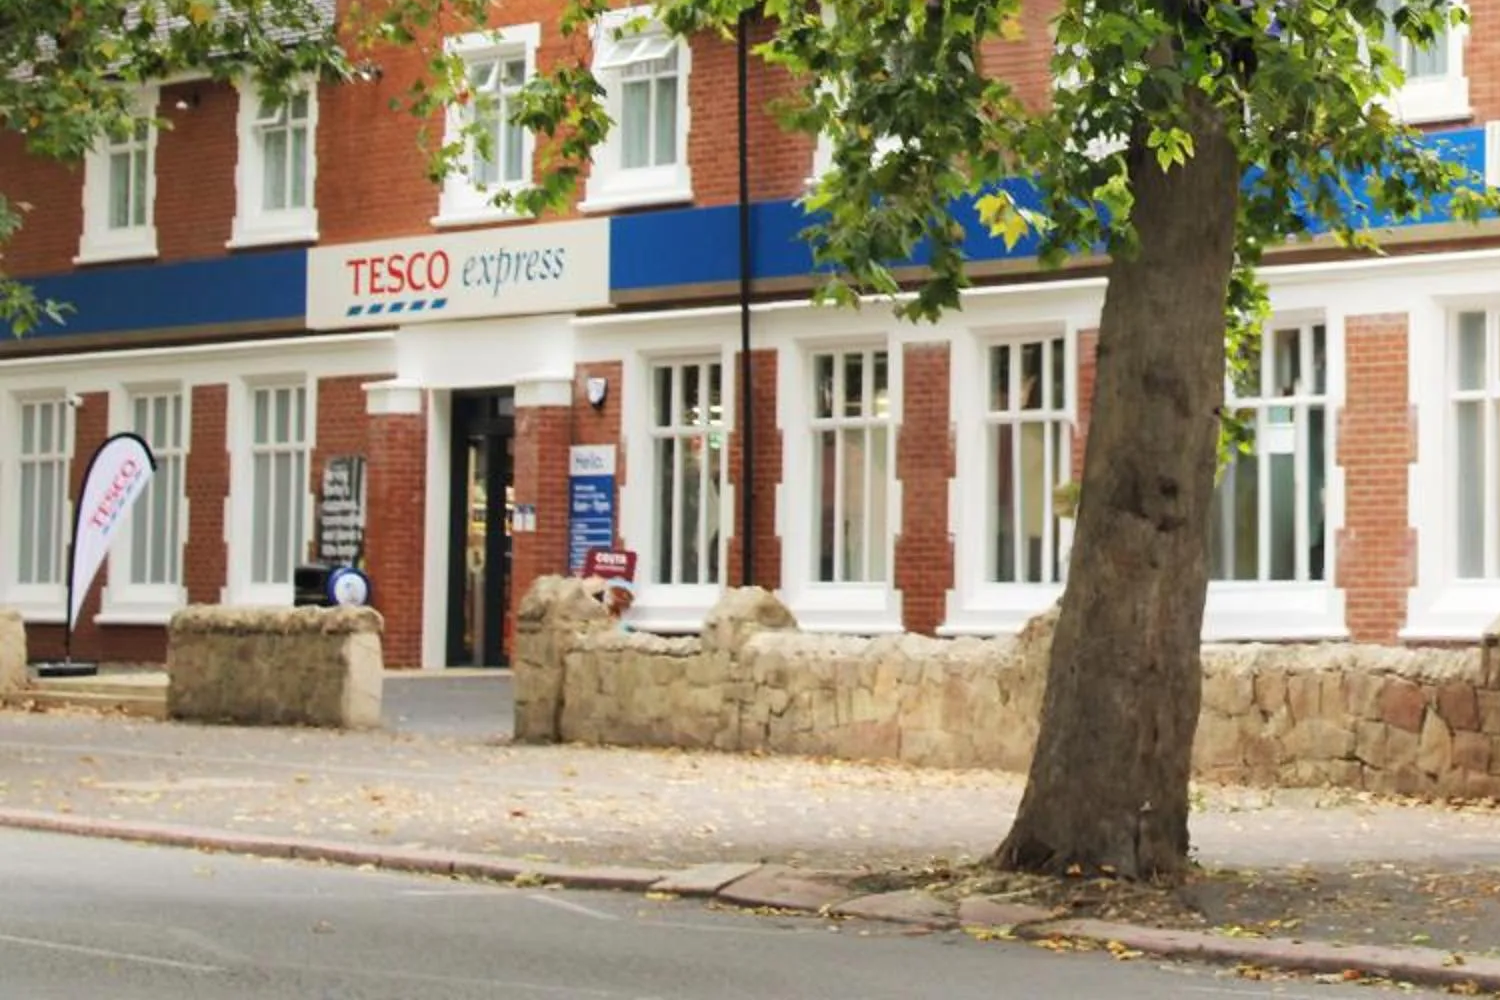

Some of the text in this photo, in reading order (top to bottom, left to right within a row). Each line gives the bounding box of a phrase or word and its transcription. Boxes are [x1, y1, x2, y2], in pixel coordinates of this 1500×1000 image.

[346, 247, 565, 296] TESCO express
[91, 459, 138, 528] TESCO
